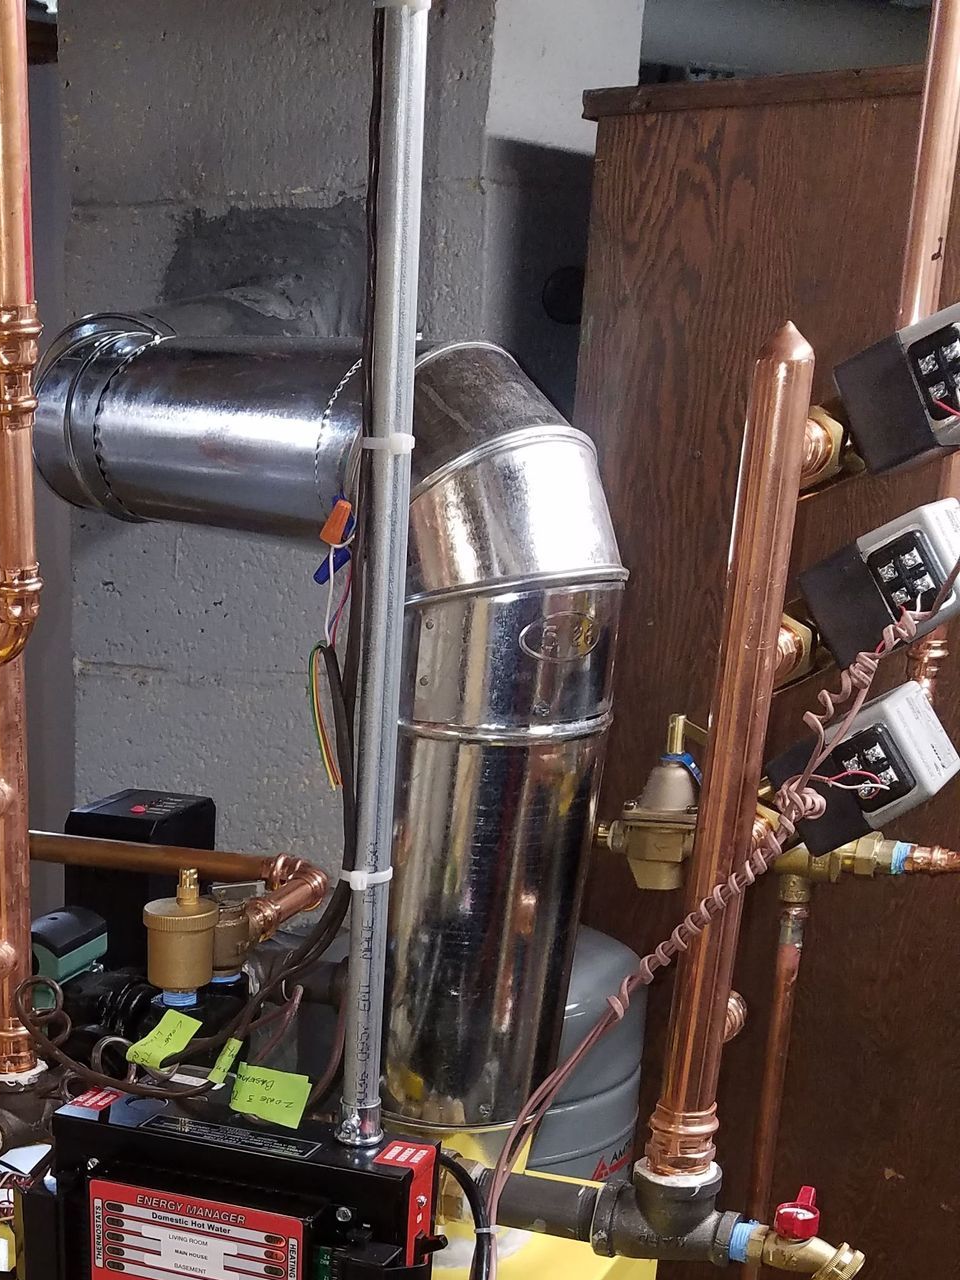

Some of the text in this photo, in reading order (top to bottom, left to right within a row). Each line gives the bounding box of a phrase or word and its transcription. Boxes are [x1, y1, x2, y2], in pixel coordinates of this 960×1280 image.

[136, 1195, 246, 1224] ENERGY MANAGER
[95, 1205, 103, 1260] THERMOSTATS
[151, 1212, 231, 1234] Domestic Hot Water
[168, 1234, 208, 1247] LIVING ROOM
[188, 1252, 208, 1260] HOUSE
[288, 1243, 297, 1278] HEATING
[174, 1263, 207, 1275] BASEMENT
